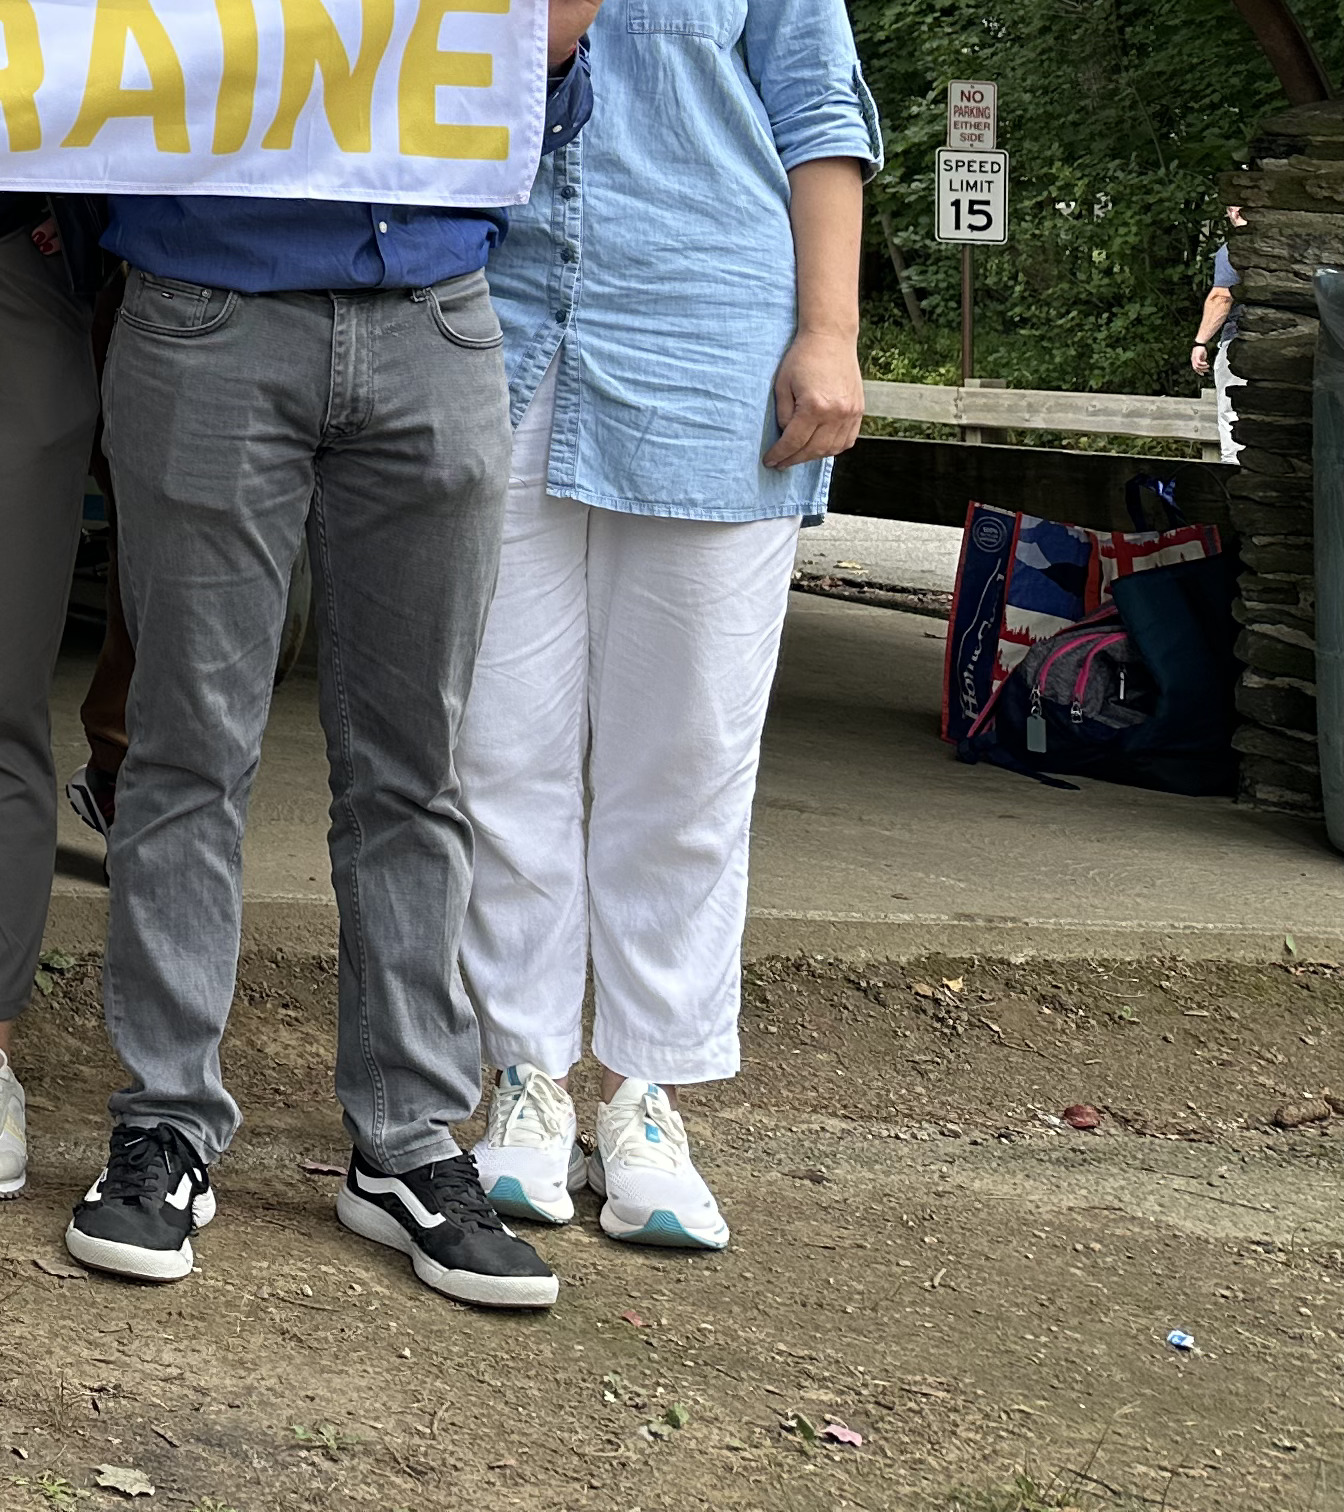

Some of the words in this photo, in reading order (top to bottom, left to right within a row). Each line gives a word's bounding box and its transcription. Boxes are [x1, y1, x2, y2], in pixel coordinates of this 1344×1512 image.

[960, 90, 984, 103] NO
[953, 105, 991, 119] PARKING
[953, 121, 991, 131] EITHER
[959, 133, 984, 143] SIDE
[943, 159, 1002, 174] SPEED
[949, 178, 994, 193] LIMIT
[950, 198, 993, 232] 15
